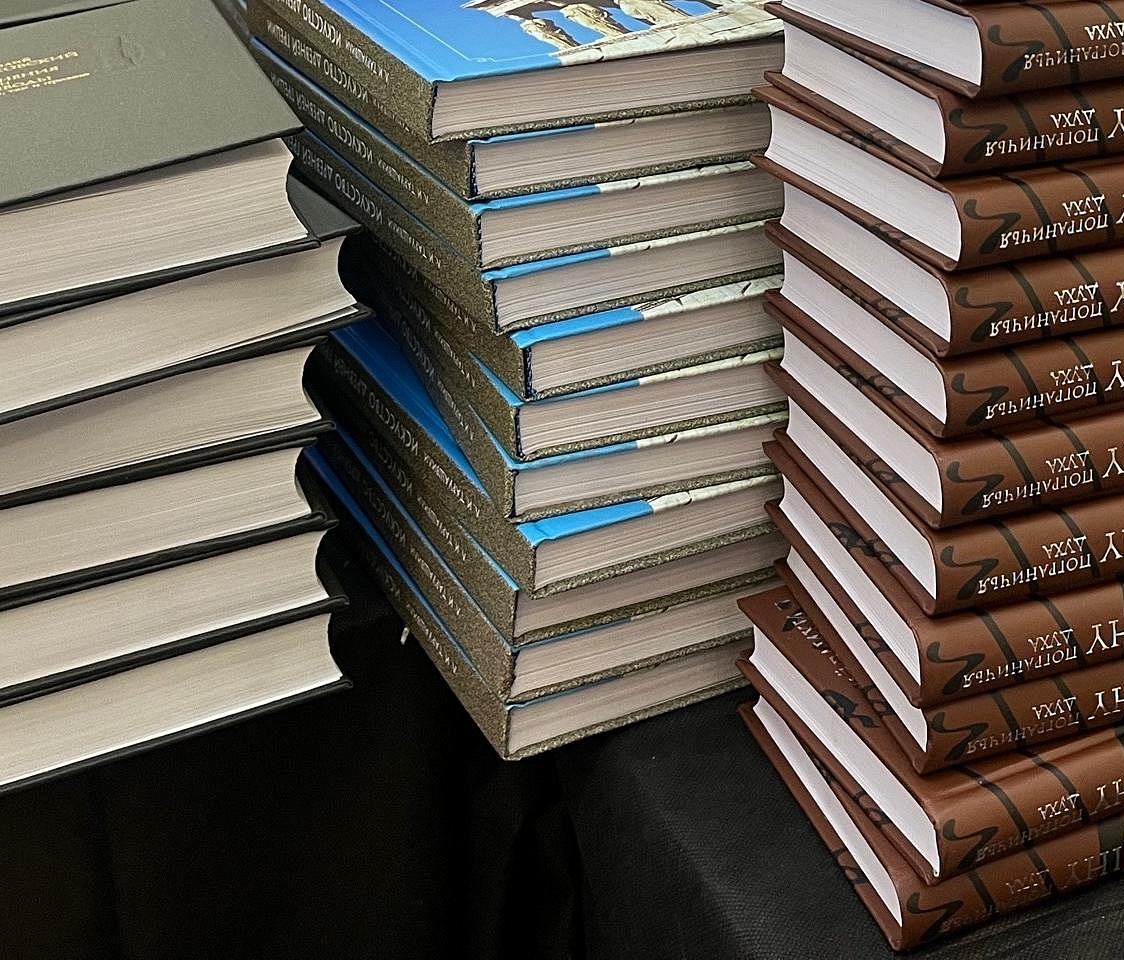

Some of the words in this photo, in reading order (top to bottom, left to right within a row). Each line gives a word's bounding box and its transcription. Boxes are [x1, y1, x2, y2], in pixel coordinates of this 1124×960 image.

[1050, 108, 1096, 129] ДУХА
[985, 127, 1099, 156] ПОГРАНИЧЬЯ
[1062, 193, 1105, 218] ДУХА
[999, 213, 1109, 248] ПОГРАНИЧЬЯ
[1053, 282, 1100, 306] ДУХА
[989, 300, 1103, 337] ПОГРАНИЧЬЯ
[1050, 363, 1094, 386] ДУХА
[985, 382, 1097, 420] ПОГРАНИЧЬЯ
[1045, 450, 1089, 473] ДУХА
[982, 469, 1093, 508] ПОГРАНИЧЬЯ
[1042, 535, 1087, 558] ДУХА
[978, 553, 1092, 593] ПОГРАНИЧЬЯ
[1027, 627, 1074, 654] ДУХА
[961, 645, 1077, 689] ПОГРАНИЧЬЯ
[1032, 696, 1077, 720] ДУХА
[965, 711, 1081, 754] ПОГРАНИЧЬЯ
[1037, 793, 1080, 820] ДУХА
